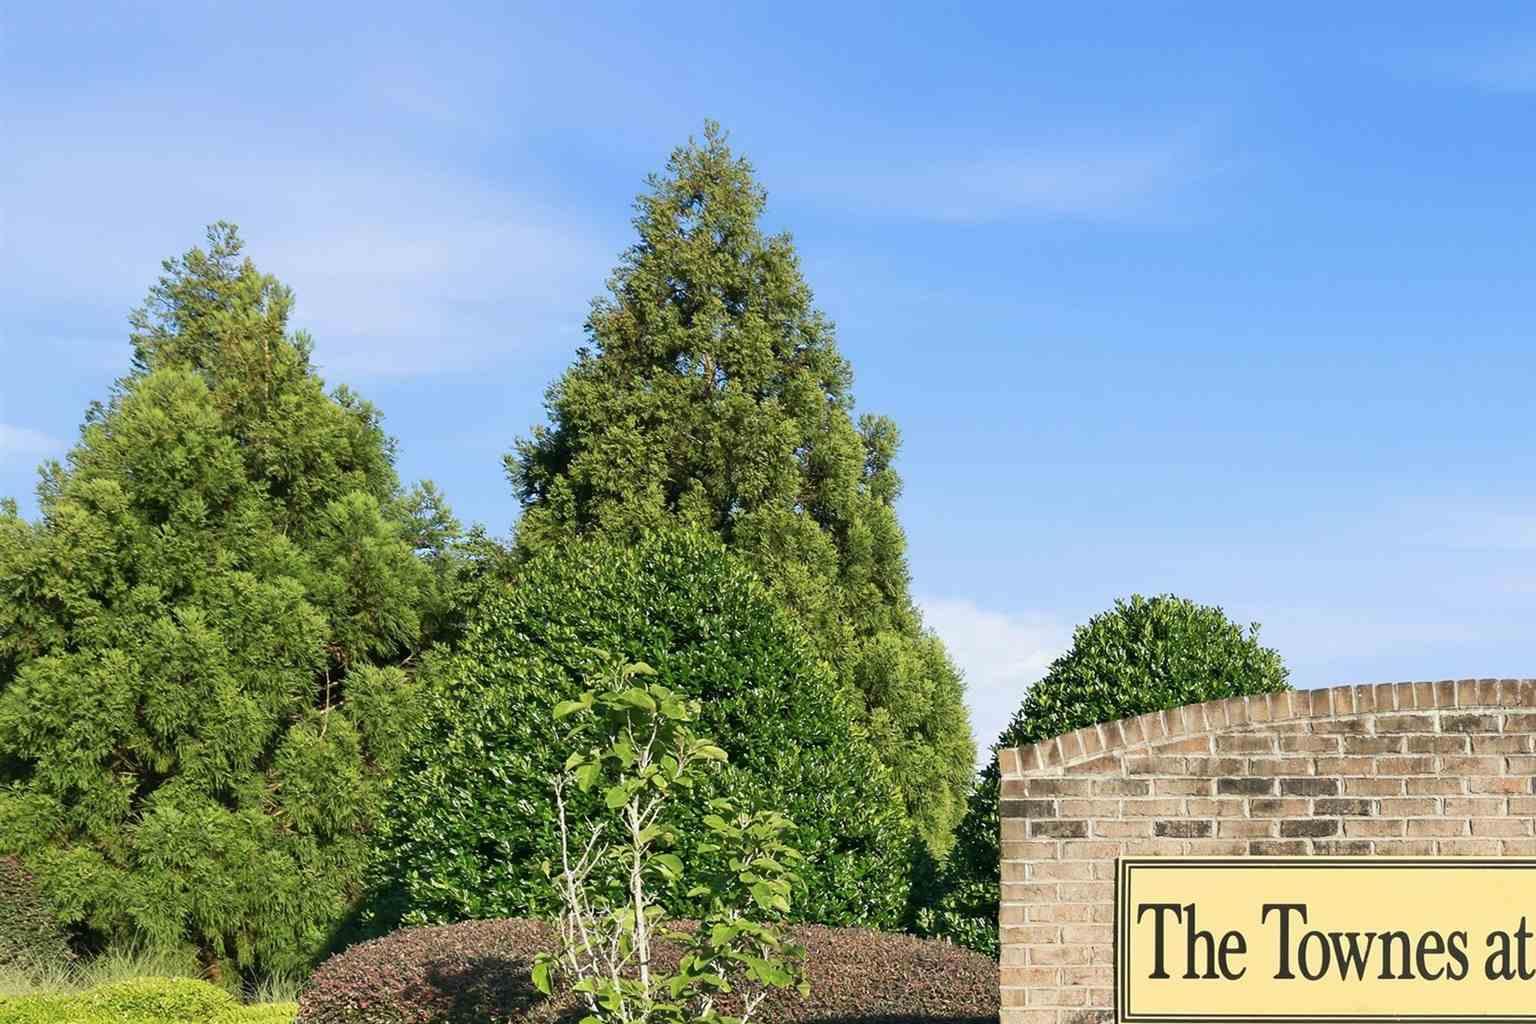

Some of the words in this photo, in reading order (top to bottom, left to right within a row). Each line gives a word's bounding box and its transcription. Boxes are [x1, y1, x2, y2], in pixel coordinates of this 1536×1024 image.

[1136, 902, 1247, 981] The
[1261, 902, 1469, 982] Townes
[1484, 915, 1536, 981] at
